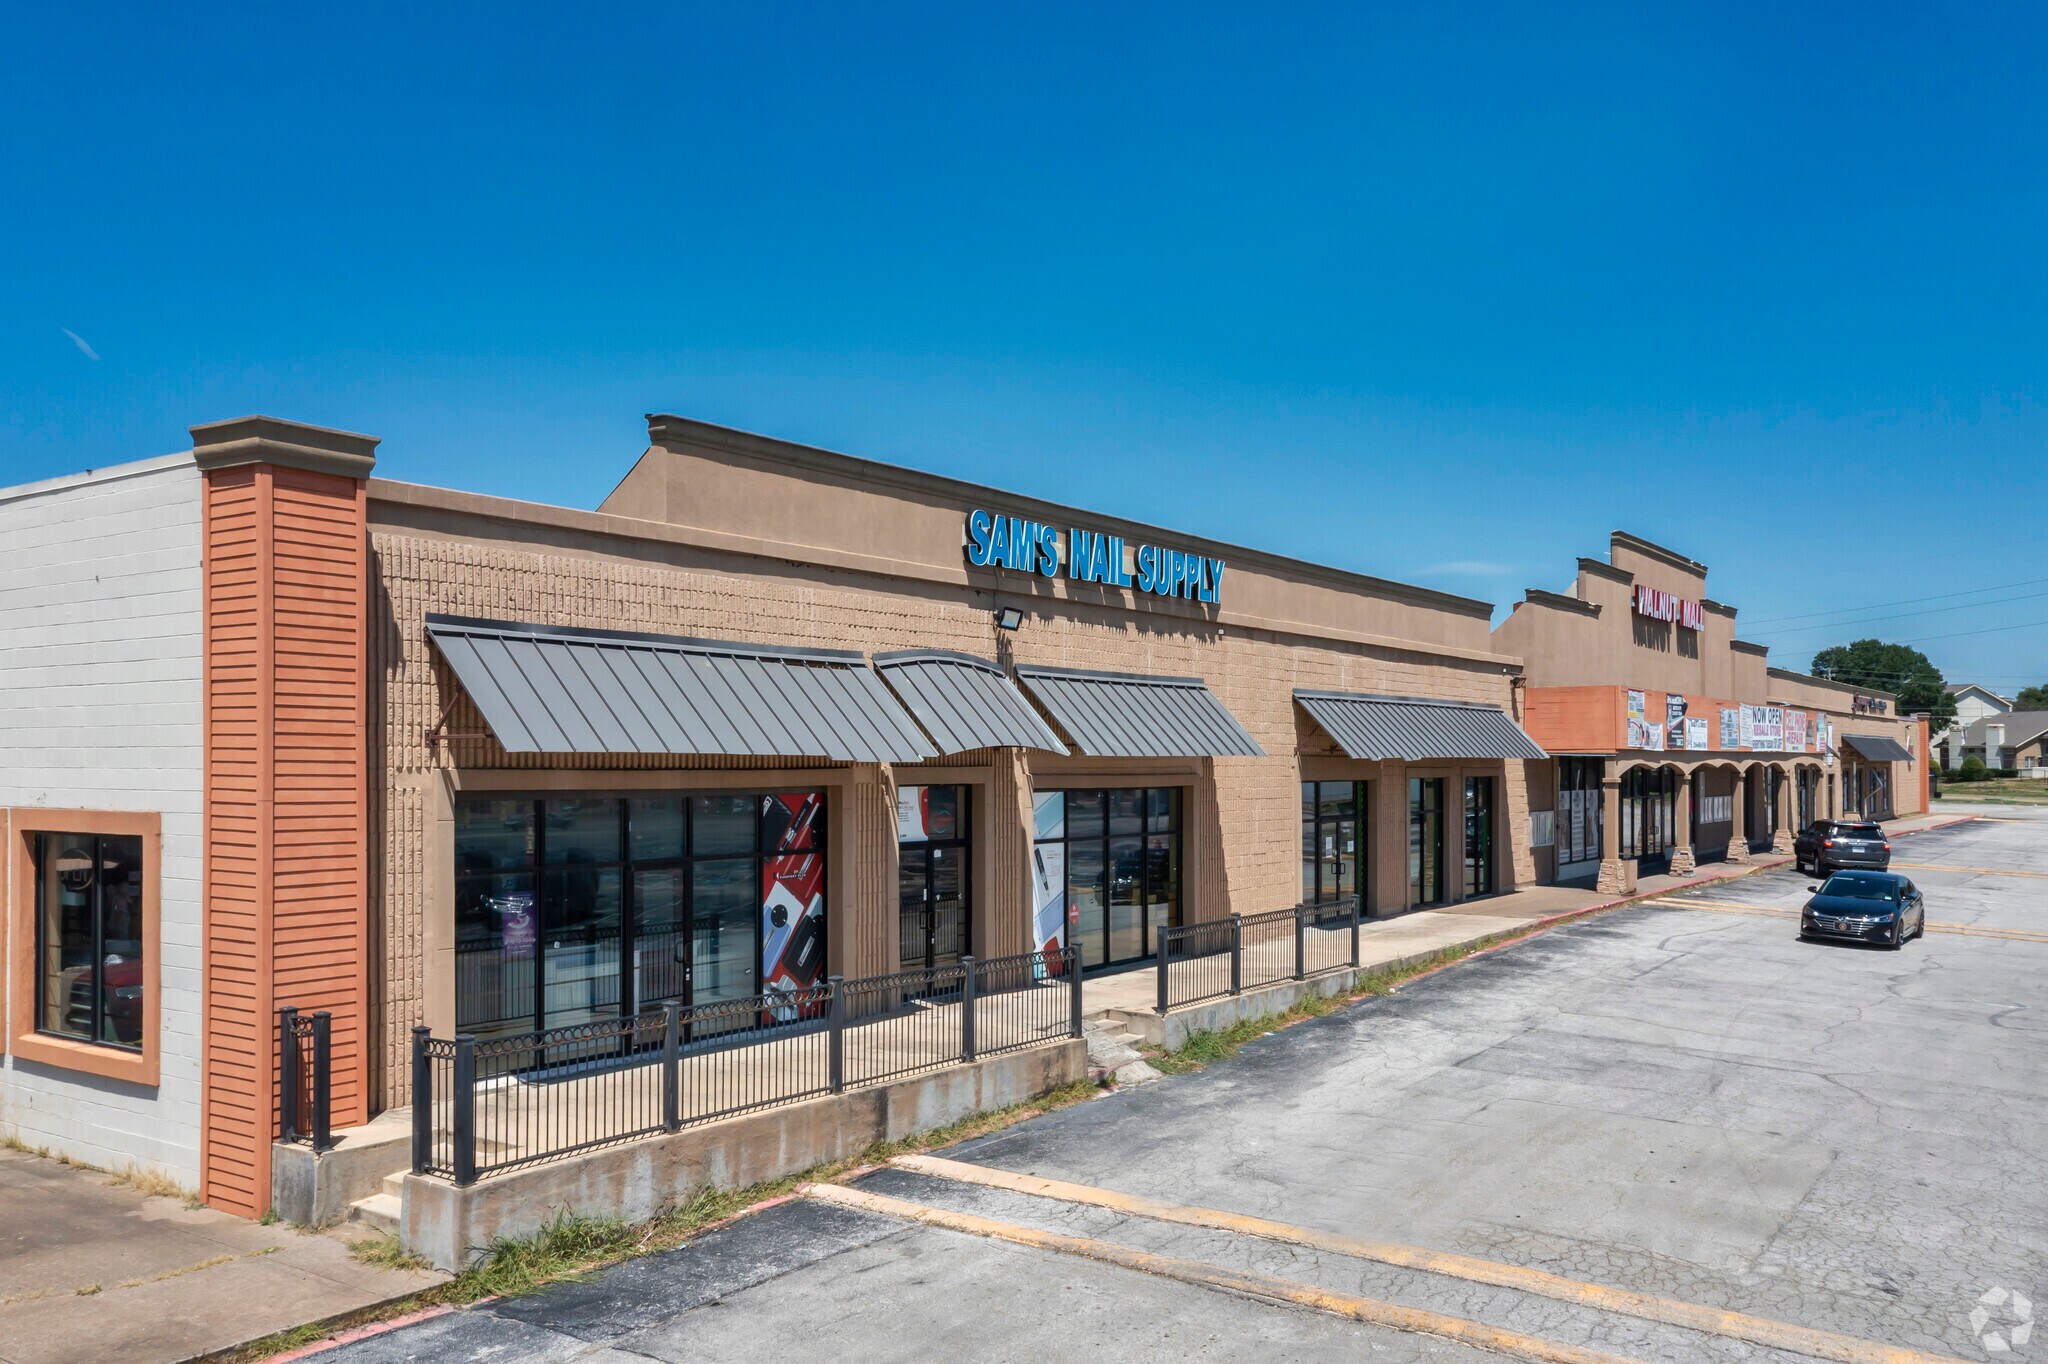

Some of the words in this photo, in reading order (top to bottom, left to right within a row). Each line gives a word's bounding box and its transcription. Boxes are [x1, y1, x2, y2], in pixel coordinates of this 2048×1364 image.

[966, 509, 1058, 578] SAM'S
[1068, 528, 1132, 587] NAIL
[1135, 544, 1225, 604] SUPPLY
[1636, 584, 1678, 624] WALNUT
[1680, 599, 1704, 632] MALL
[1752, 706, 1766, 723] NOW
[1768, 708, 1782, 724] OPEN
